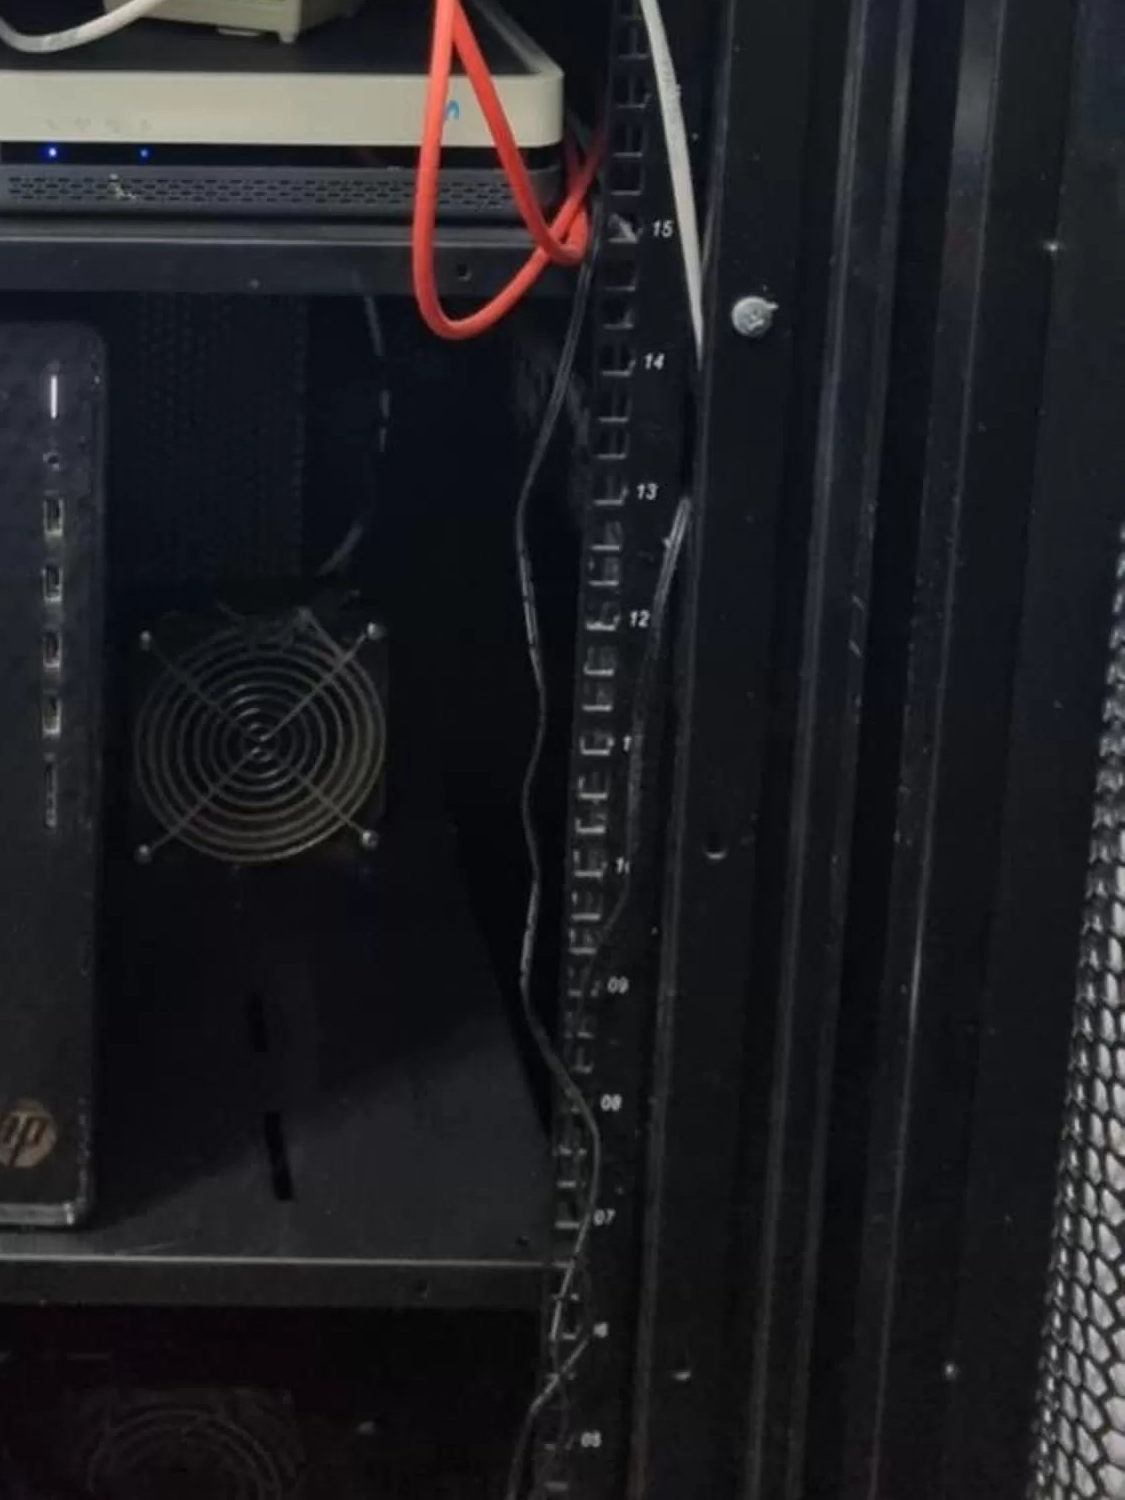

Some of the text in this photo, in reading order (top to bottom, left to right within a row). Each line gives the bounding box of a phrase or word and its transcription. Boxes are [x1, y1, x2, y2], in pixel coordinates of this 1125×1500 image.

[654, 220, 672, 237] 15
[646, 354, 664, 369] 14
[637, 483, 658, 500] 13
[631, 610, 650, 627] 12
